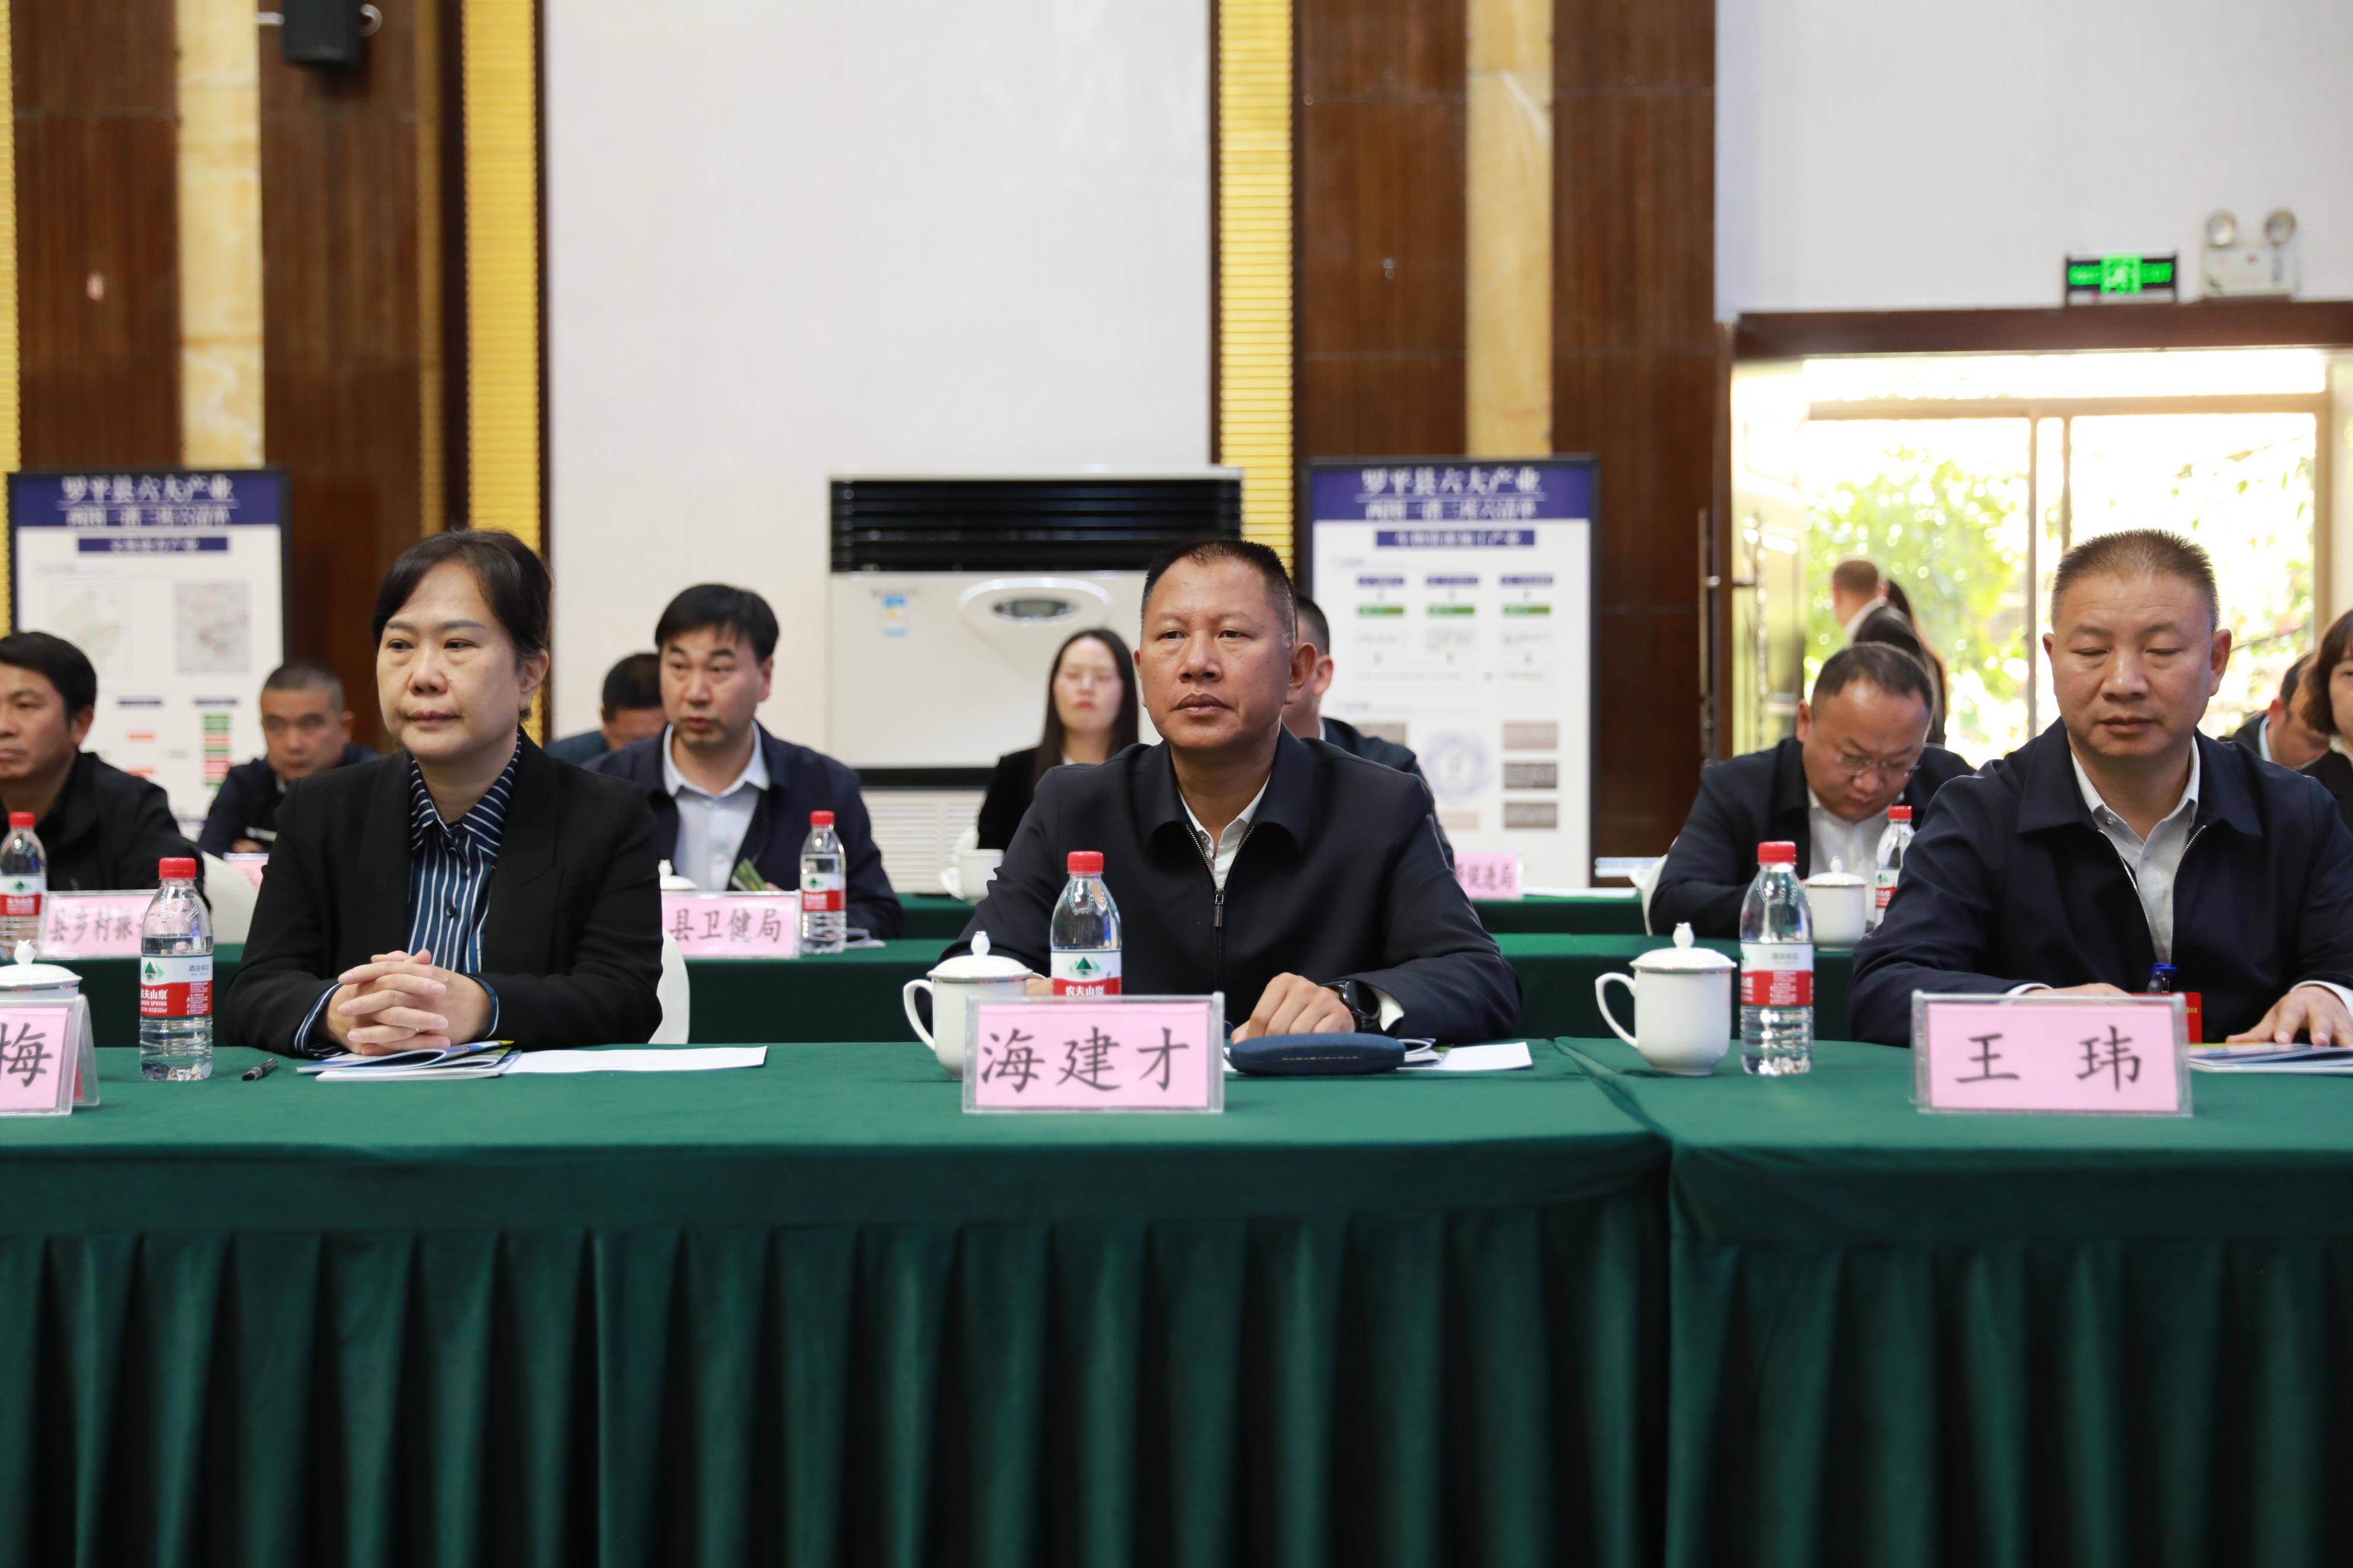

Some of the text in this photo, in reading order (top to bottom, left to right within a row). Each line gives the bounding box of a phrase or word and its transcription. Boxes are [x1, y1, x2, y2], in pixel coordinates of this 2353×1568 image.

[49, 907, 144, 944] 县乡村振
[669, 908, 782, 943] 县卫健局
[1065, 985, 1105, 997] 农夫山泉
[0, 1022, 54, 1087] 梅
[980, 1026, 1190, 1093] 海建才
